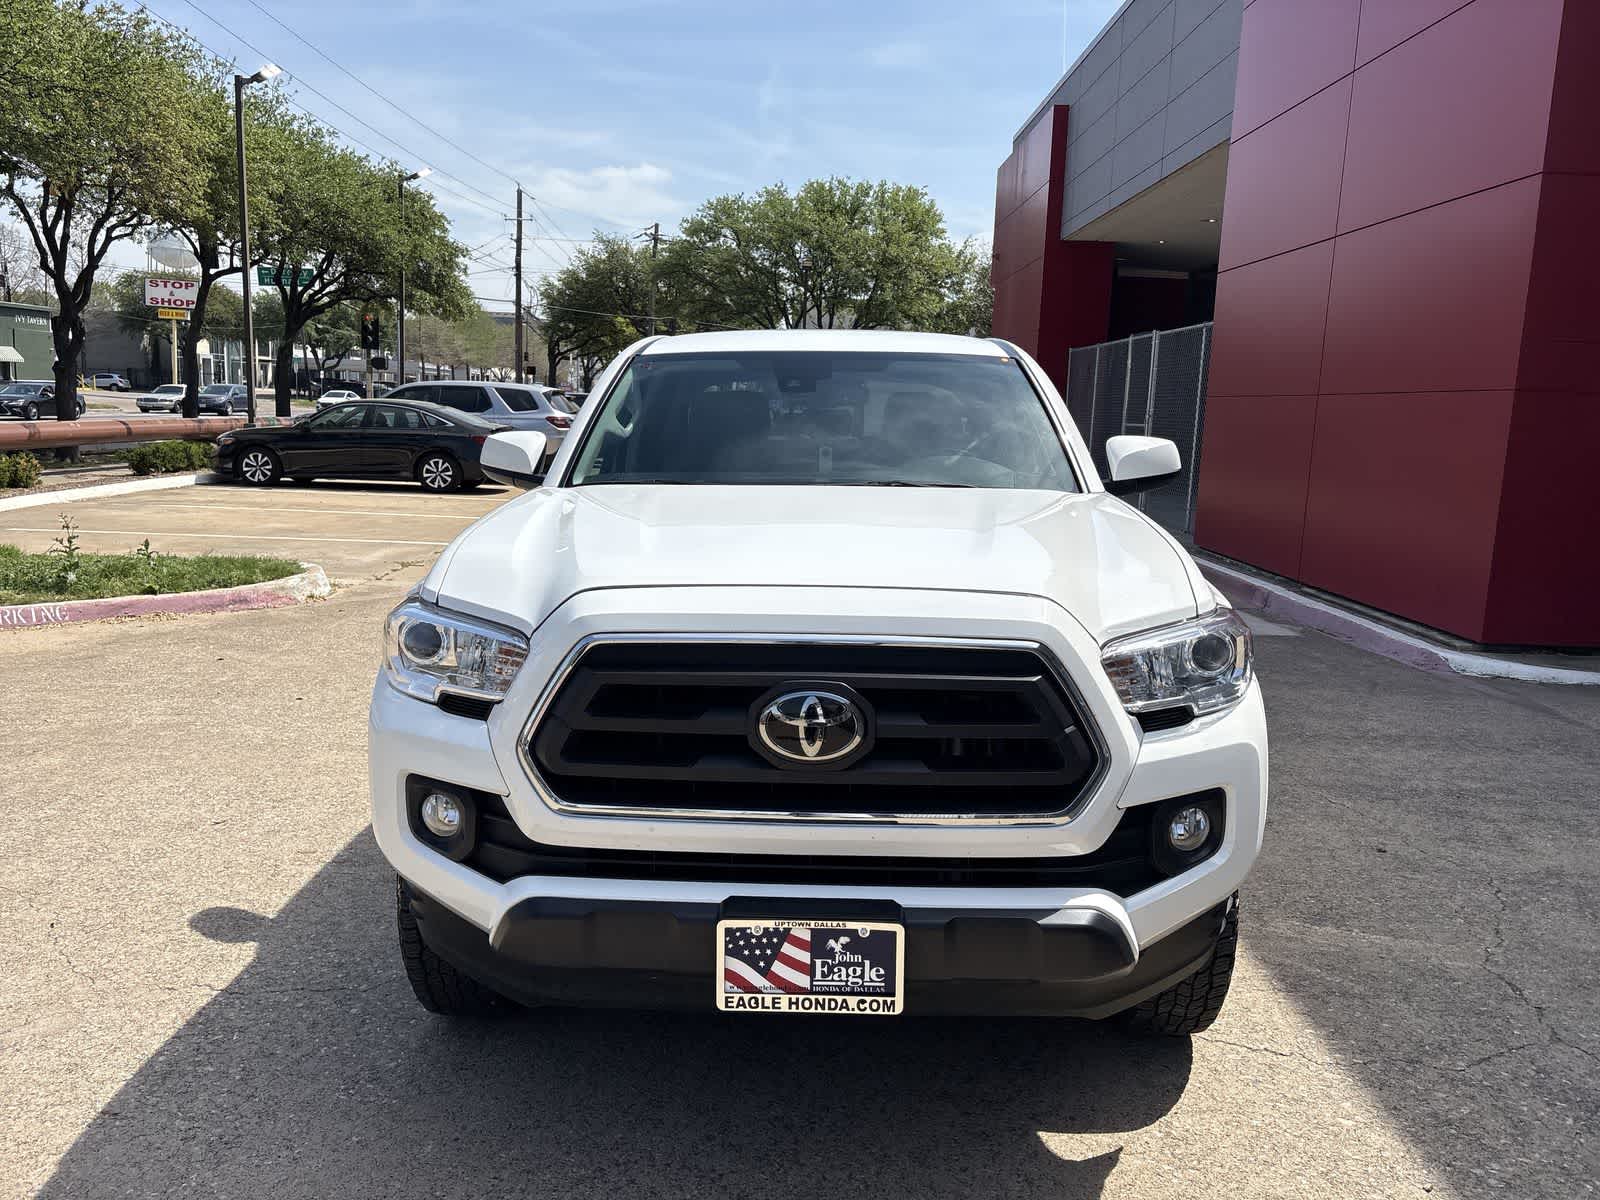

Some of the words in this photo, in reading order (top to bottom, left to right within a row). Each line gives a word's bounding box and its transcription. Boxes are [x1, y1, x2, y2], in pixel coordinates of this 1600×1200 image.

[149, 280, 194, 289] STOP
[150, 297, 195, 307] SHOP
[15, 315, 25, 323] IVY
[833, 952, 862, 964] John
[813, 959, 885, 985] Eagle
[724, 996, 781, 1010] EAGLE
[788, 998, 896, 1012] HONDA.COM
